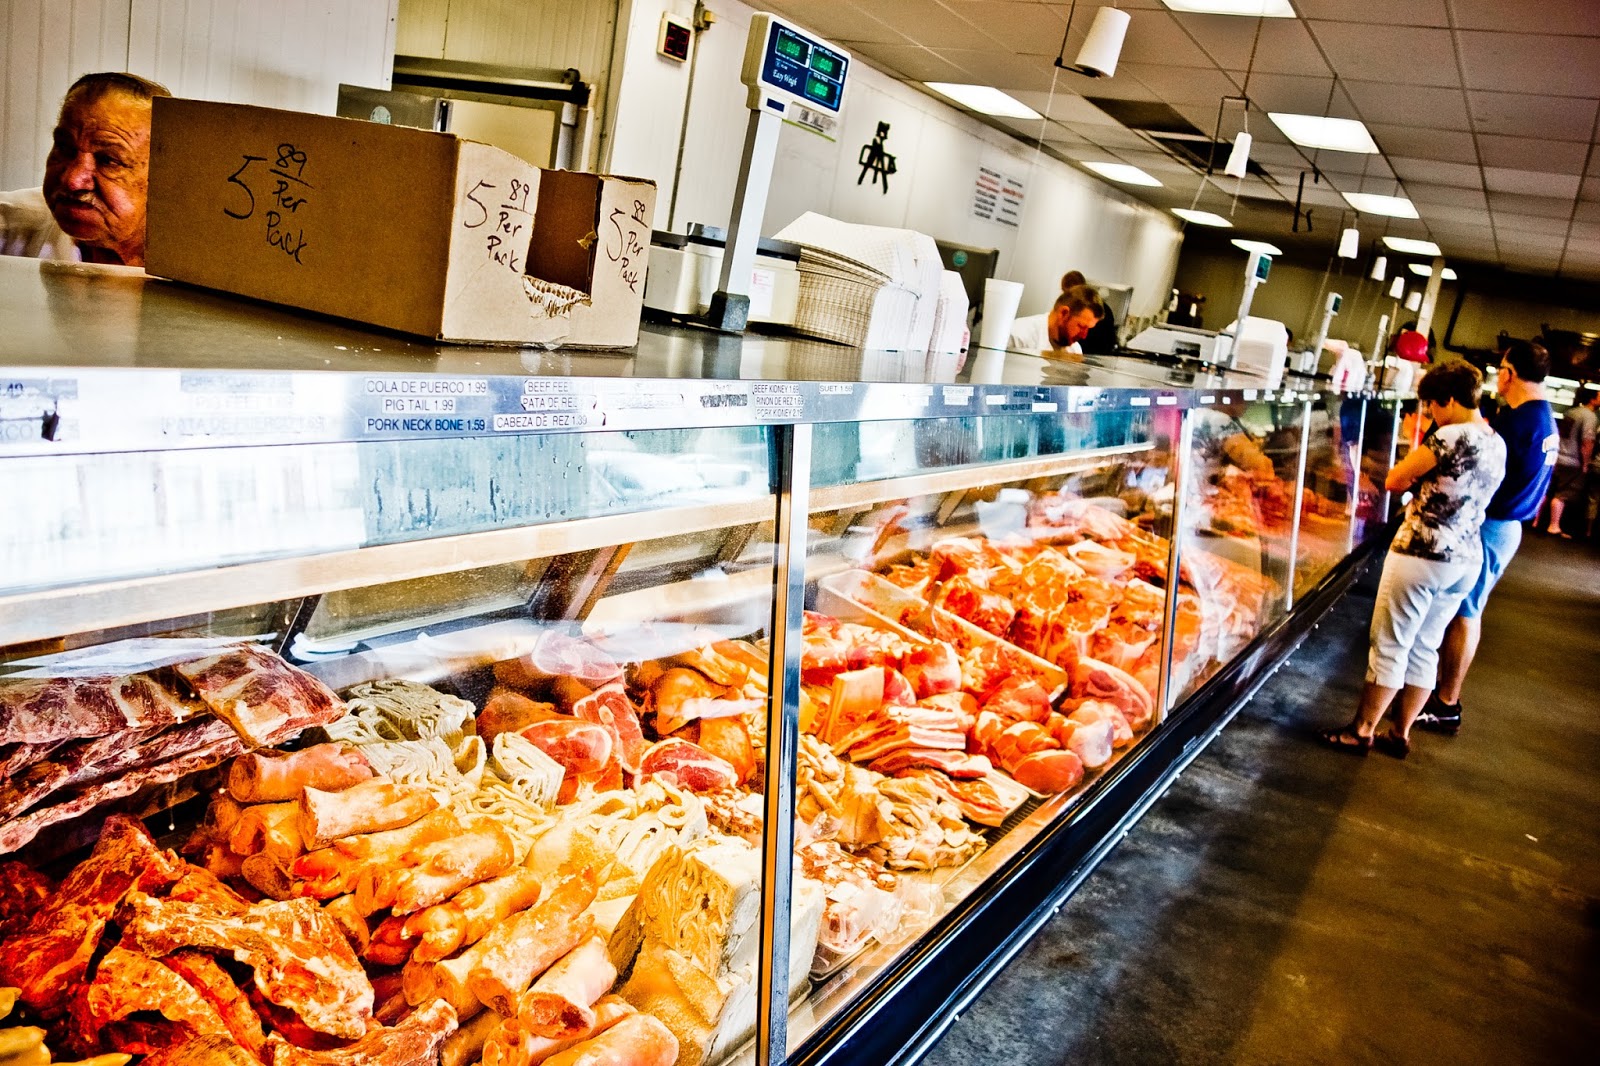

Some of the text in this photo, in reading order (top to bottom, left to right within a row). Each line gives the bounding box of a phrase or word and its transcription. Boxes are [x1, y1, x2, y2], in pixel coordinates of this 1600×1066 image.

[224, 143, 307, 220] 5 89
[272, 179, 308, 213] Per
[463, 178, 530, 228] 5 89
[496, 211, 522, 237] Per
[606, 199, 646, 262] 5 89
[266, 210, 308, 265] Pack
[628, 231, 644, 257] Per
[487, 235, 519, 273] Pack
[620, 256, 638, 294] Pack
[367, 380, 486, 393] COLA DE PUERCO 1.99
[527, 380, 572, 393] BEEF FEE
[754, 384, 769, 394] BEEF
[769, 384, 788, 393] KIDNEY
[819, 384, 838, 392] SUET
[385, 399, 454, 411] PIG TAIL 1.99
[523, 397, 546, 409] PATA
[549, 397, 560, 409] DE
[774, 396, 782, 406] DE
[367, 418, 485, 431] PORK NECK BONE 1.59
[496, 416, 533, 429] CABEZA
[535, 415, 548, 428] DE
[552, 415, 570, 428] REZ
